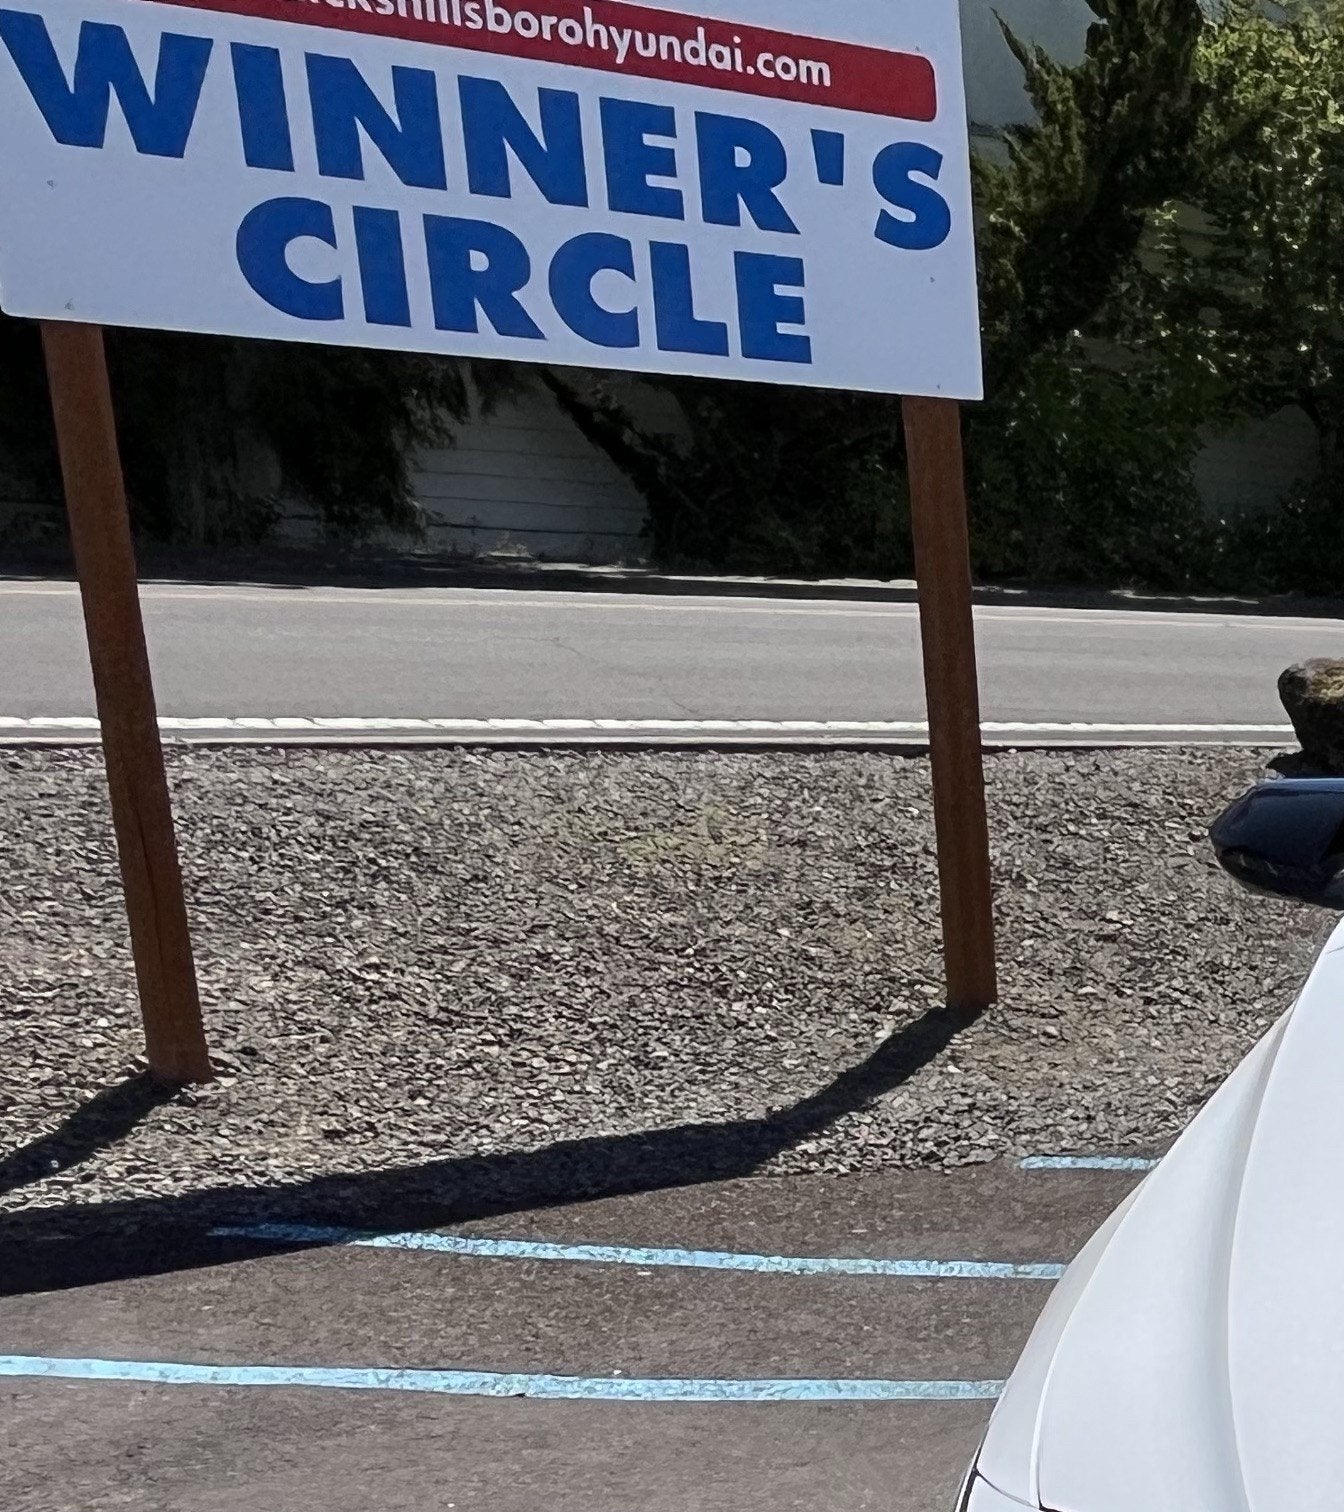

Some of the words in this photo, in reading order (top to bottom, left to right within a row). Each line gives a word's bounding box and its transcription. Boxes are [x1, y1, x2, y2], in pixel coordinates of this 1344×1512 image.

[308, 0, 831, 88] sillsborohyundai.com
[0, 8, 951, 251] WINNER'S
[236, 197, 812, 364] CIRCLE
